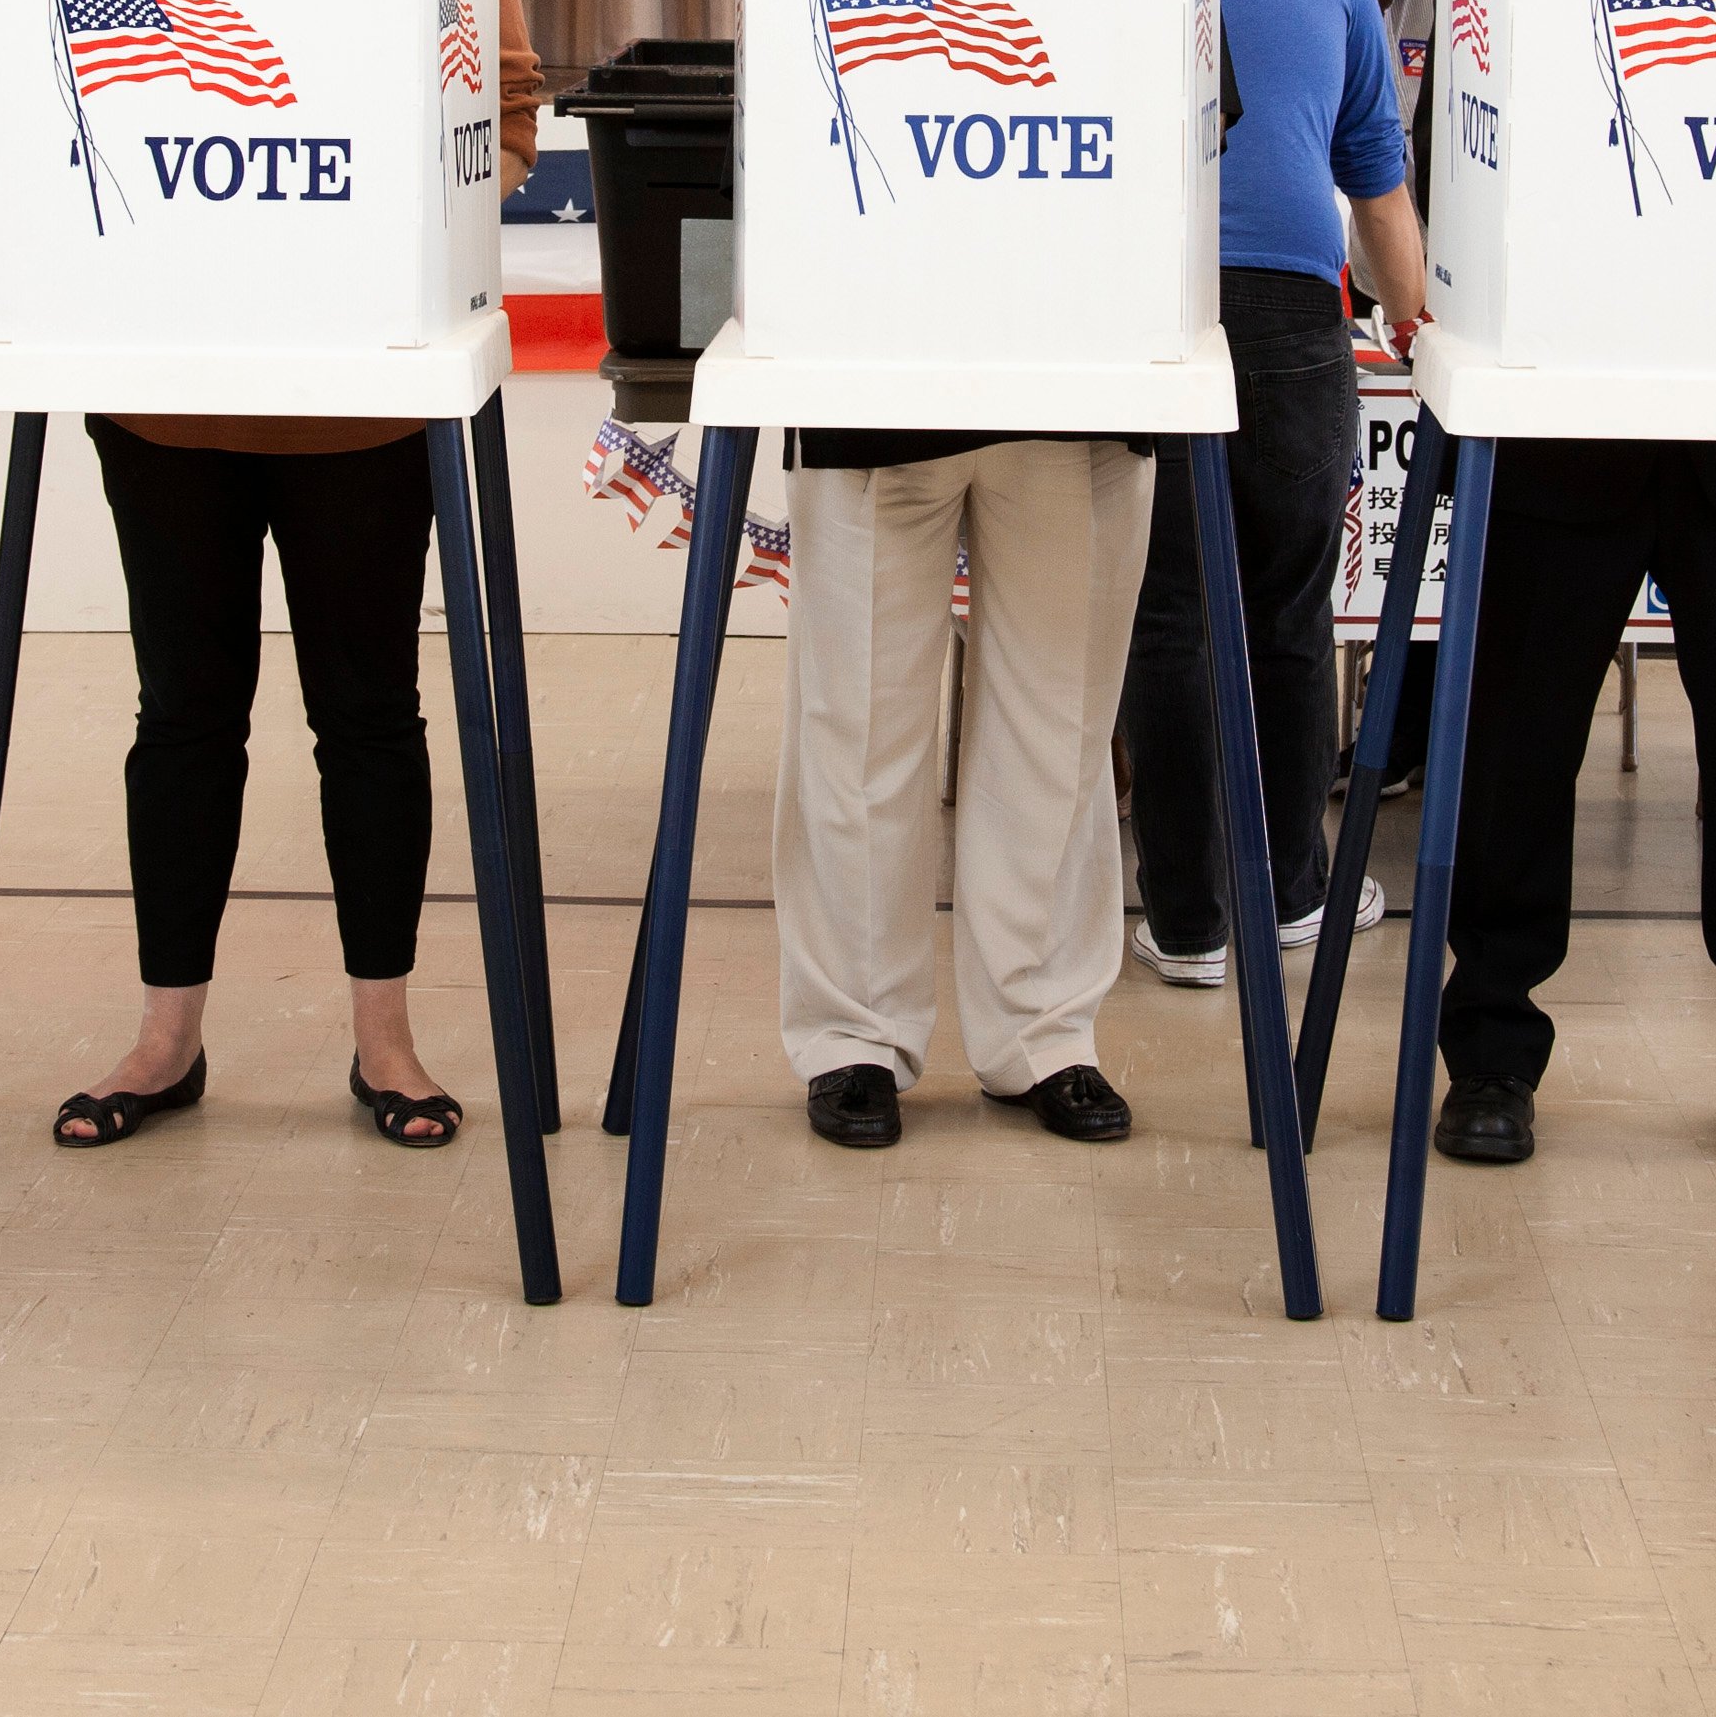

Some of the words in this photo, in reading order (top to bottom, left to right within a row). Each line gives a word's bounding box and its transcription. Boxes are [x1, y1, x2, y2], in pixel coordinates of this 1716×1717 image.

[453, 118, 492, 188] VOTE
[905, 114, 1113, 179] VOTE
[1462, 91, 1499, 171] VOTE
[145, 136, 352, 201] VOTE
